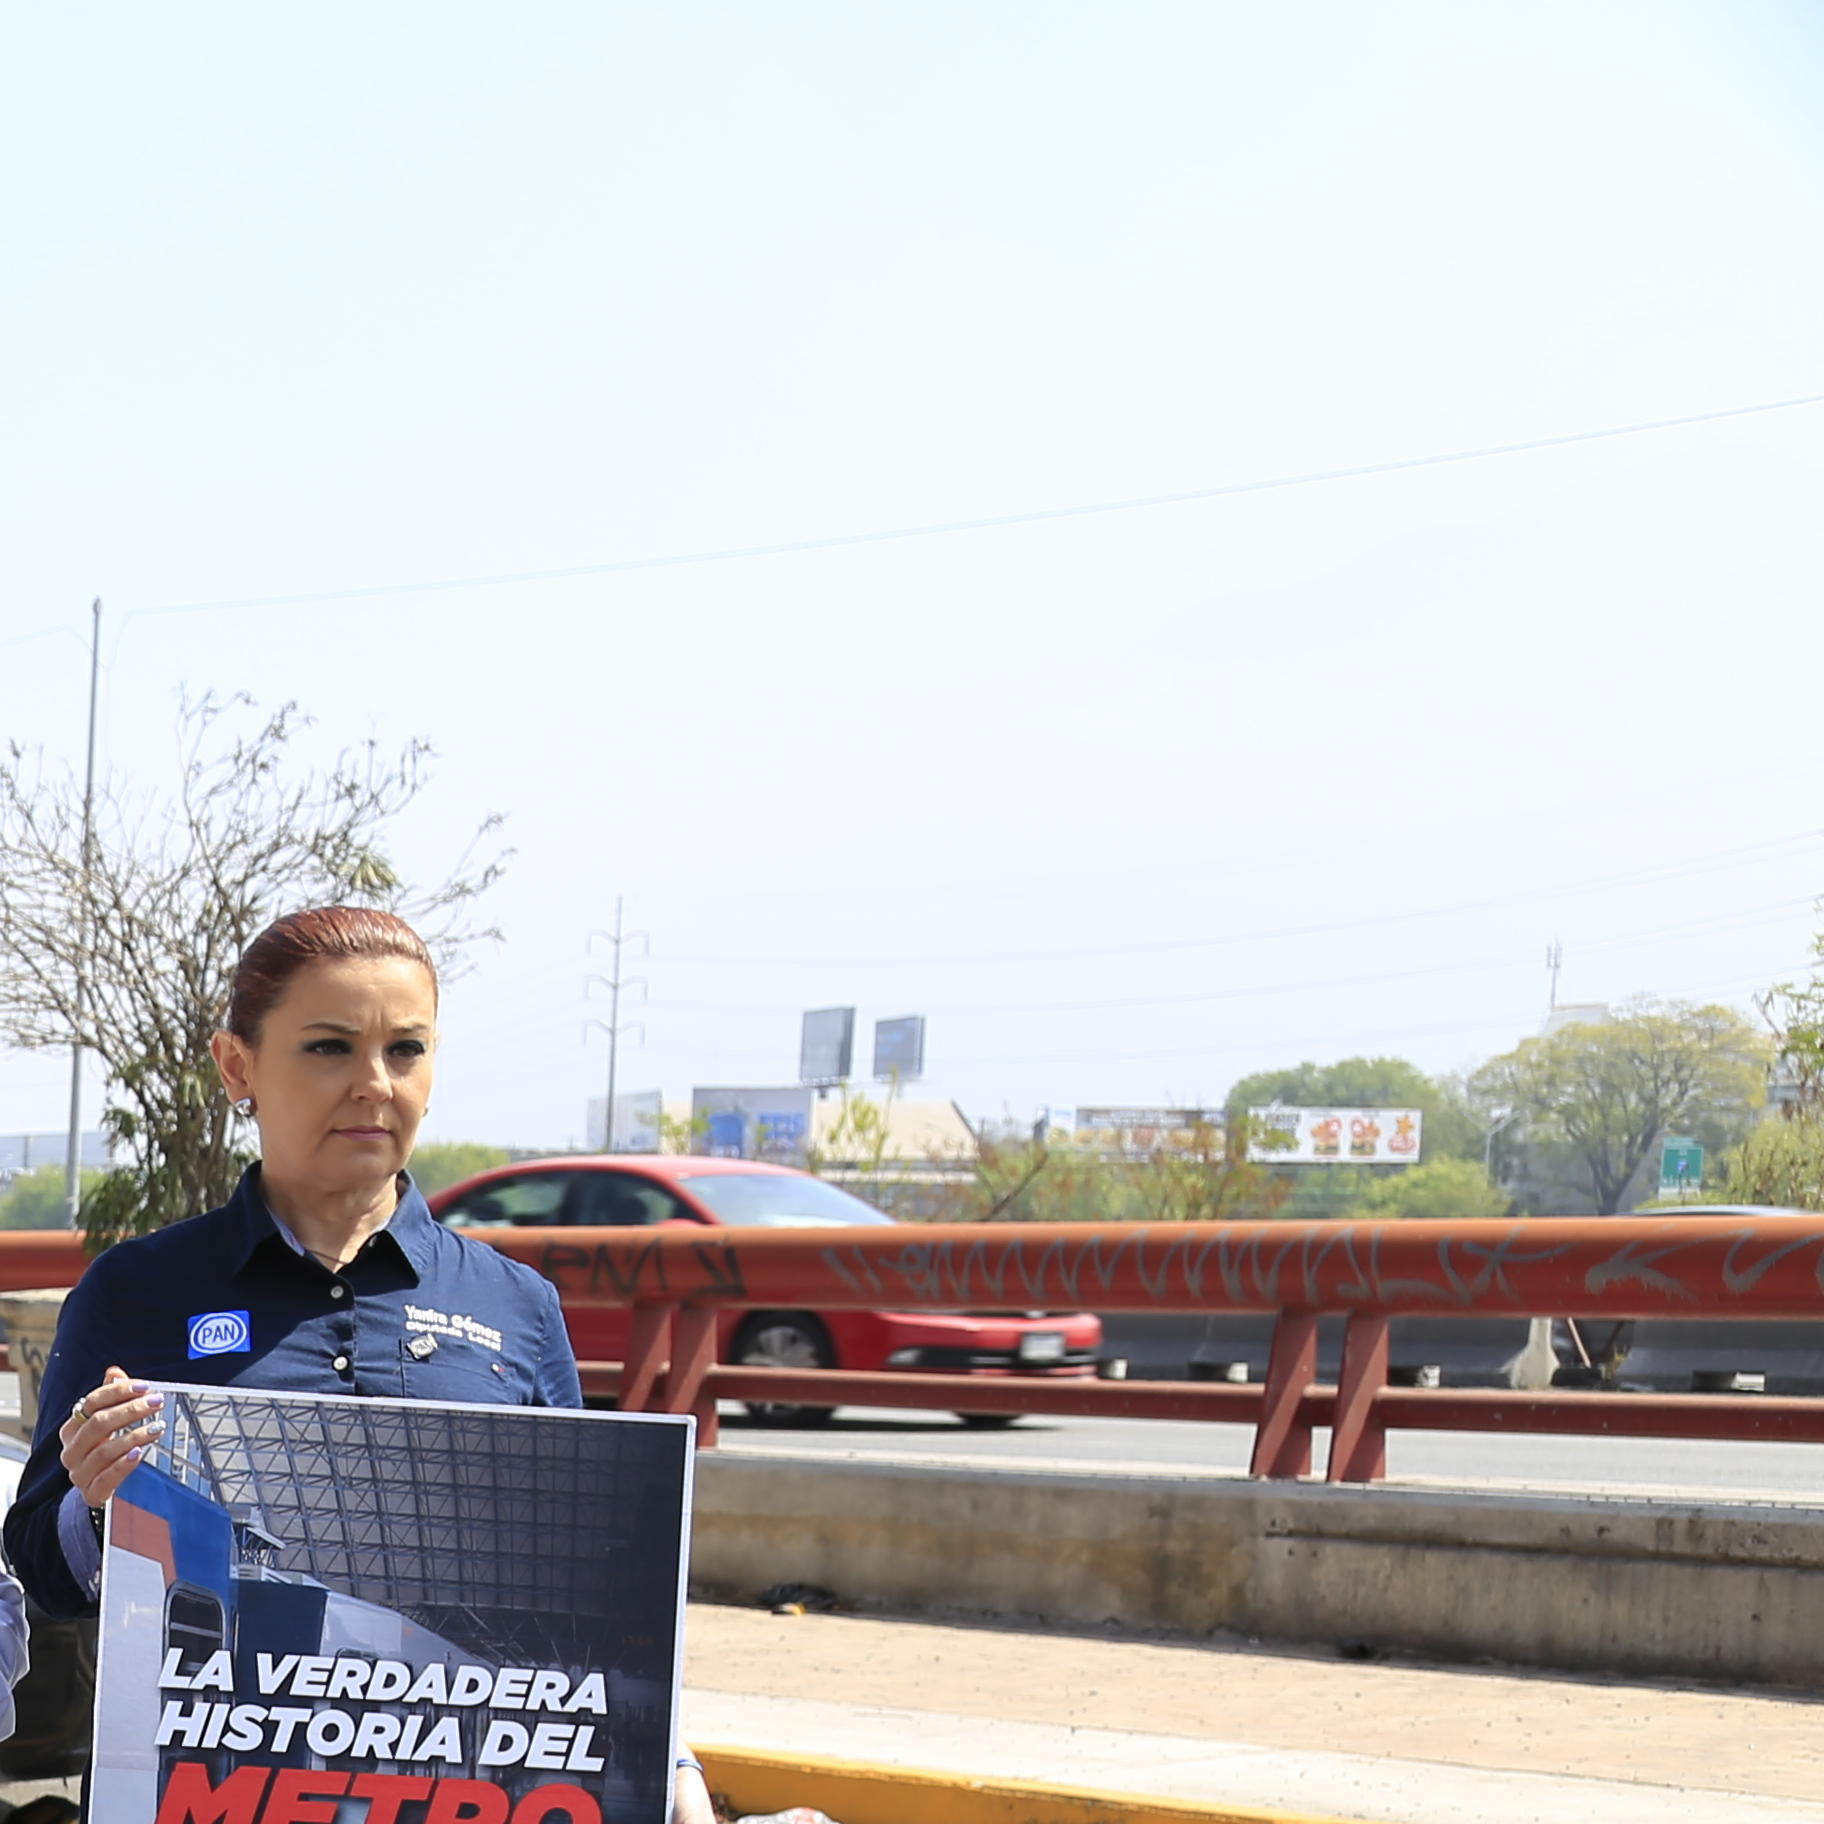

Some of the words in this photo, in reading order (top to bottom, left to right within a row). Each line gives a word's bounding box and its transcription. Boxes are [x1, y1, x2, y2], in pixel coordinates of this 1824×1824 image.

[202, 1323, 236, 1346] PAN
[404, 1304, 448, 1326] Yanira
[451, 1314, 502, 1342] Gómez
[156, 1646, 235, 1694] LA
[256, 1652, 609, 1715] VERDADERA
[154, 1701, 465, 1765] HISTORIA
[477, 1721, 607, 1773] DEL
